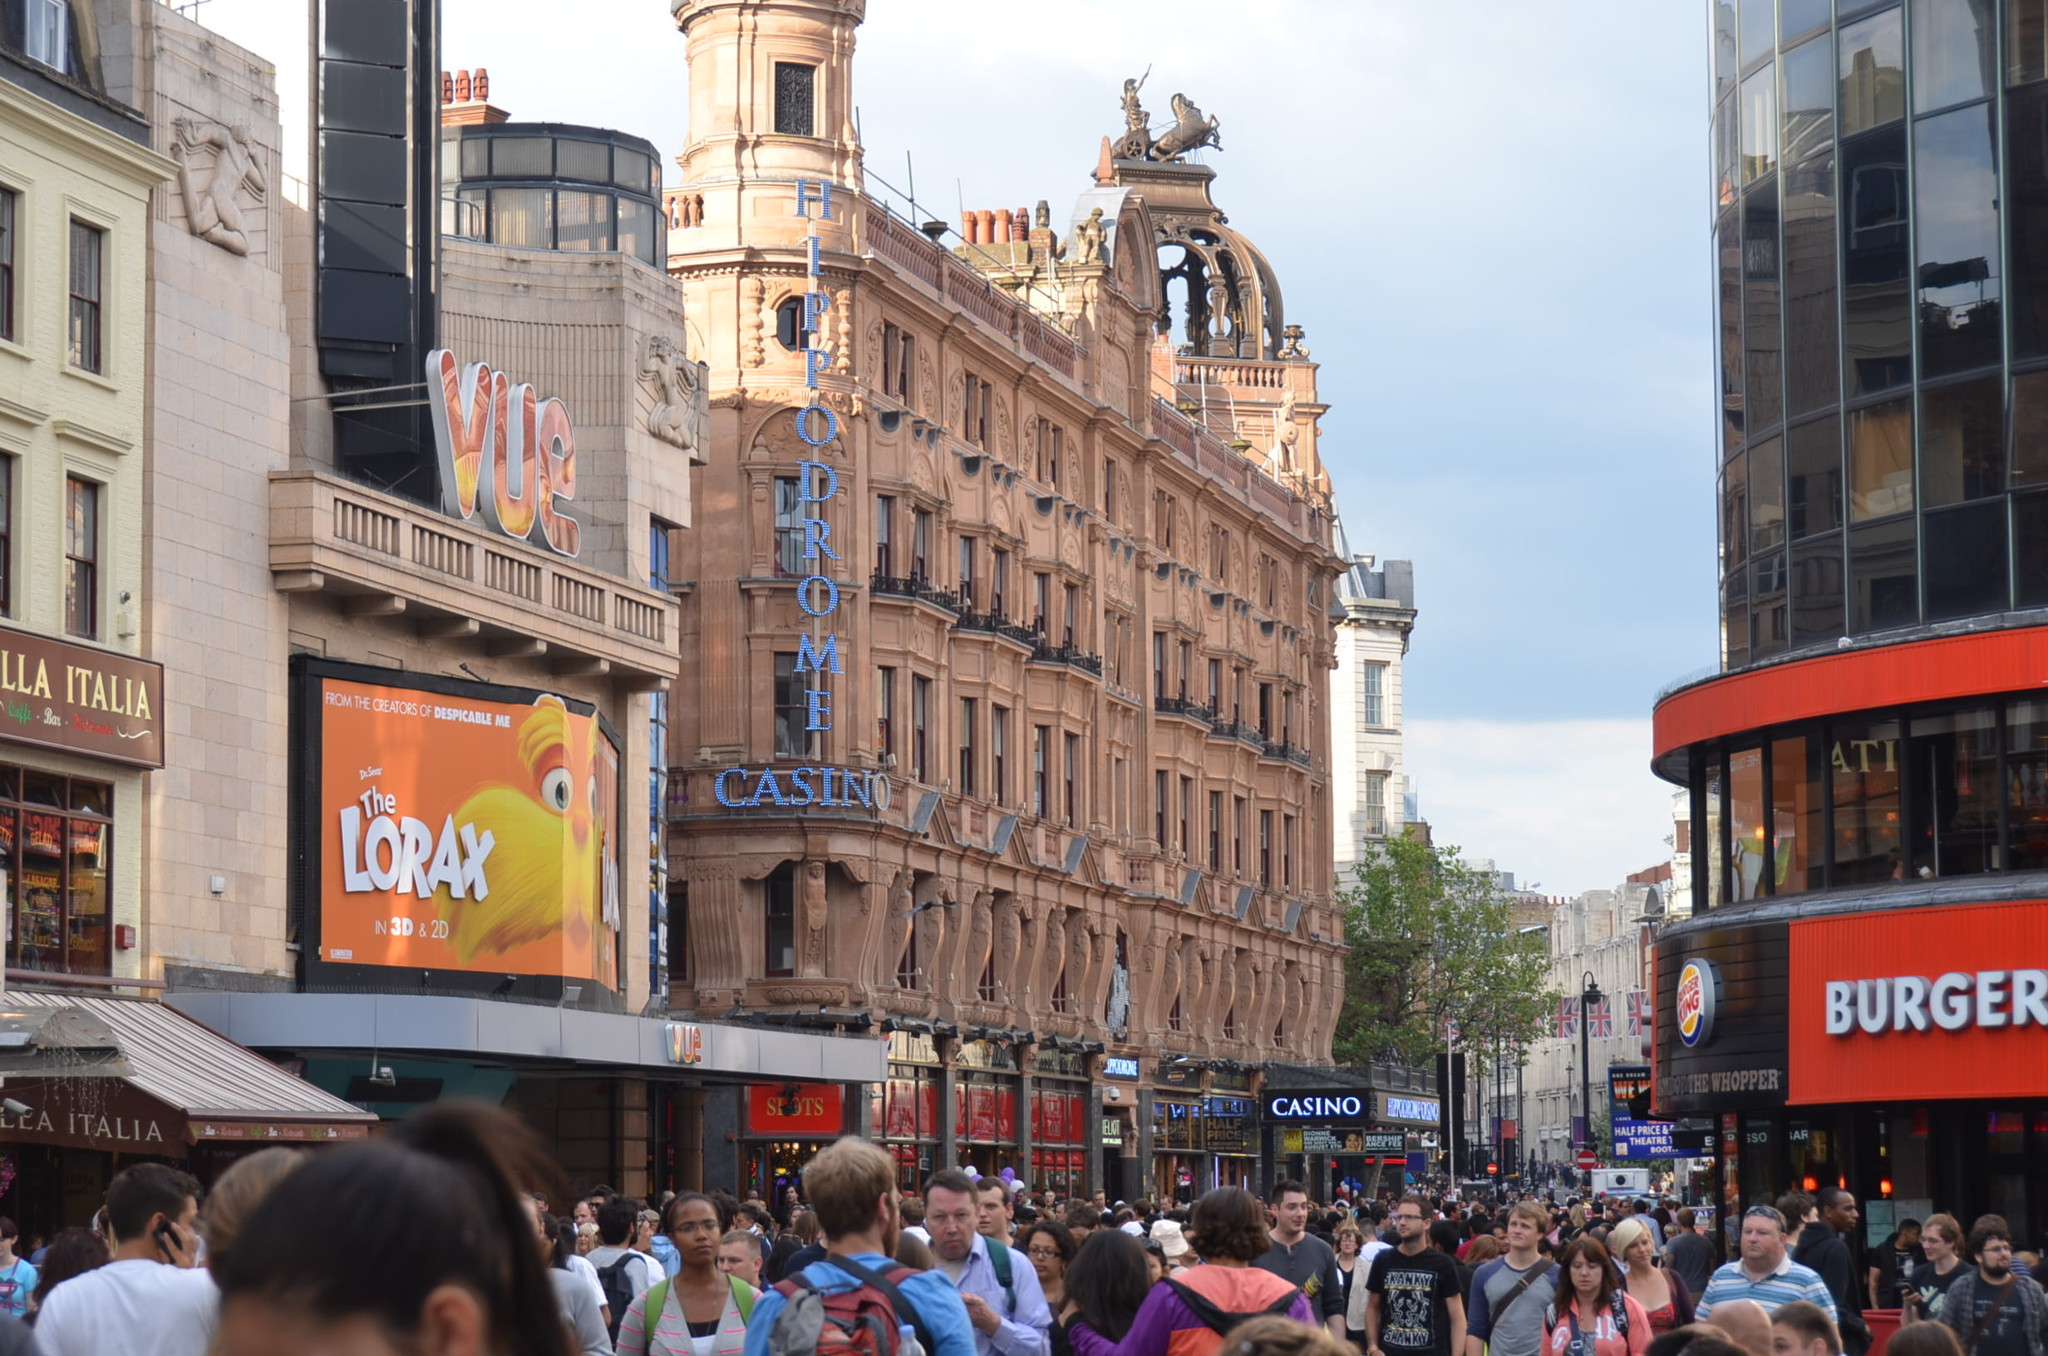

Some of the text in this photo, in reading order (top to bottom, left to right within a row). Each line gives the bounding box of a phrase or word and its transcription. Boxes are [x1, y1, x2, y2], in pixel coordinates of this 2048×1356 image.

[793, 177, 845, 732] HIPPODROME
[66, 665, 152, 720] ITALIA
[43, 707, 62, 727] Bar
[325, 692, 511, 728] FROM THE CREATORS OF DESPICABLE ME
[714, 766, 891, 811] CASINO
[360, 785, 396, 819] The
[340, 805, 496, 902] LORAX
[375, 916, 449, 939] IN 3D & 2D
[1679, 990, 1700, 1024] KING
[1826, 968, 2048, 1035] BURGER
[1613, 1080, 1636, 1099] WE
[1687, 1073, 1709, 1094] THE
[1711, 1069, 1779, 1092] WHOPPER
[1272, 1096, 1361, 1116] CASINO
[69, 1112, 163, 1142] ITALIA
[1207, 1118, 1242, 1129] HALF
[1614, 1126, 1635, 1137] HALF
[1637, 1125, 1661, 1136] PRICE
[1629, 1136, 1667, 1146] THEATRE
[1650, 1146, 1679, 1154] BOOT
[1385, 1271, 1432, 1288] SKANKY
